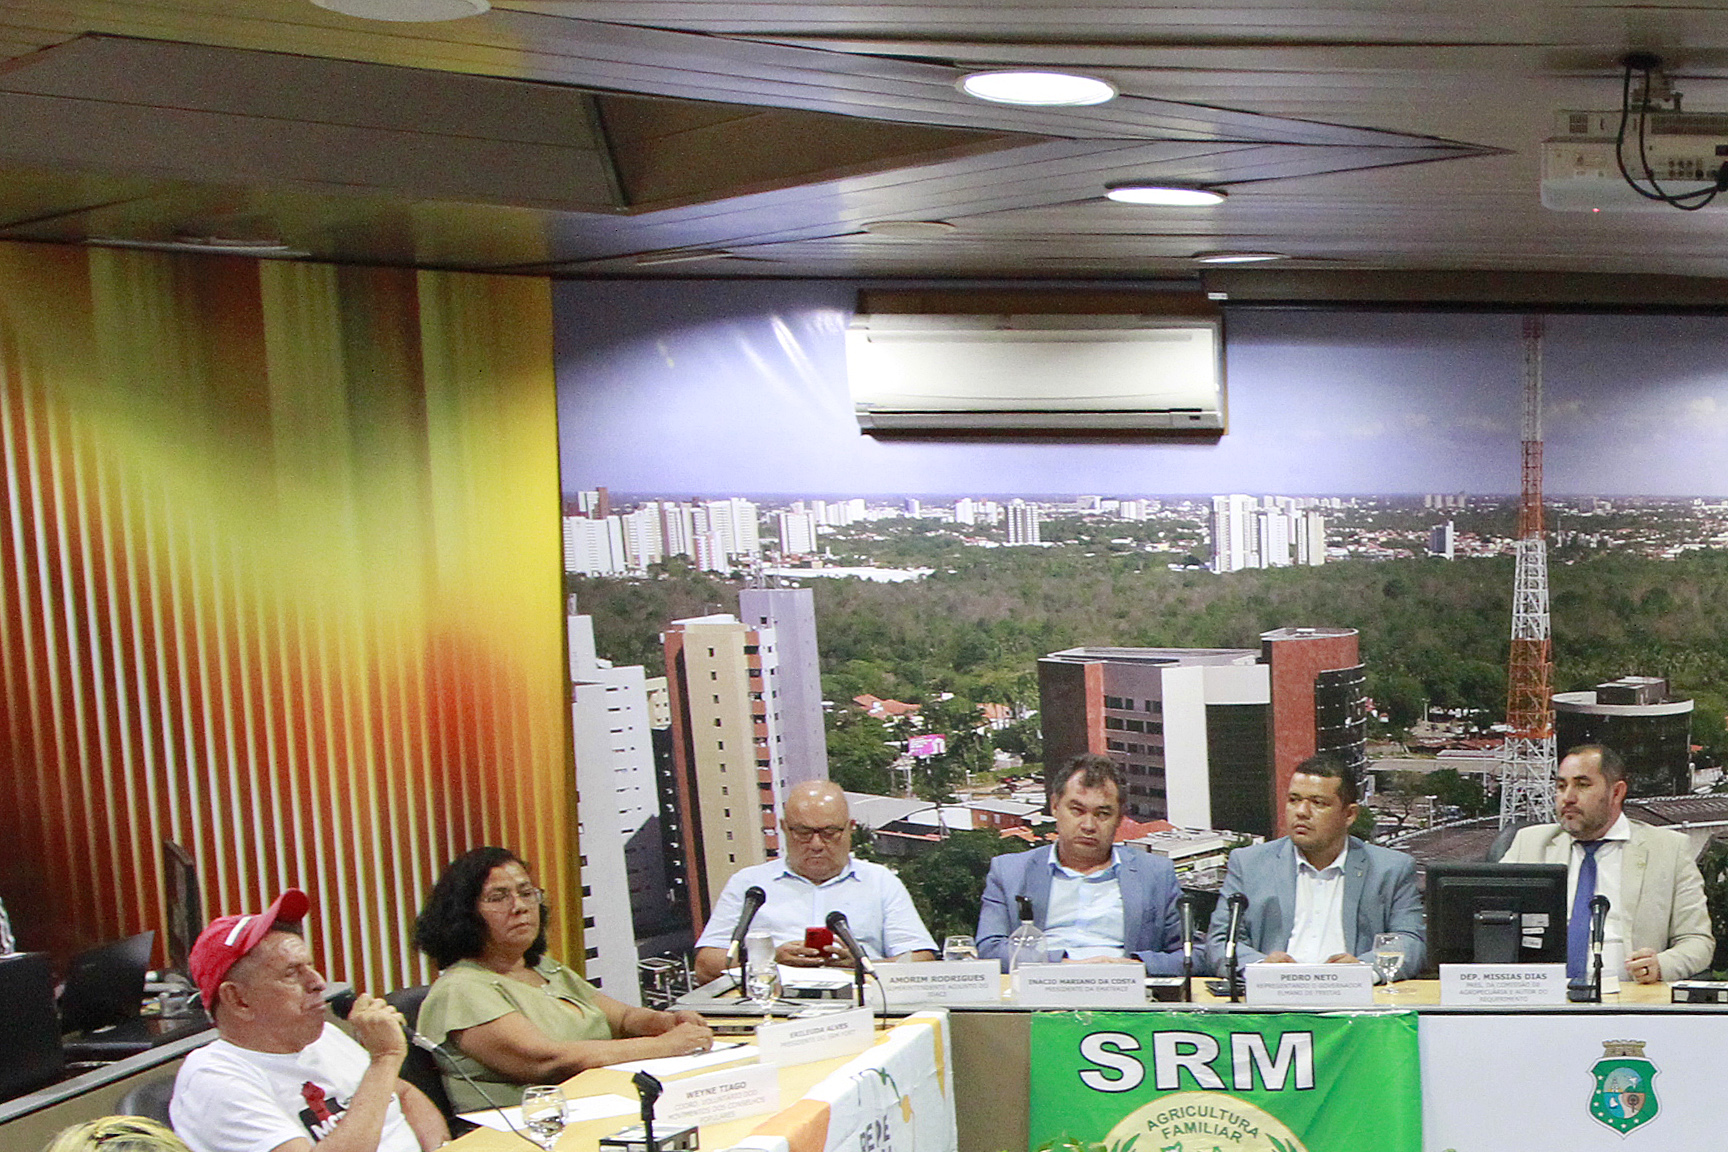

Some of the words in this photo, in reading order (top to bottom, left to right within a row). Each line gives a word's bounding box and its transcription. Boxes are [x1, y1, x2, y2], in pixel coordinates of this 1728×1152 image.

[931, 974, 985, 982] RODRIGUES
[1078, 1030, 1316, 1093] SRM
[686, 1086, 716, 1099] WEYNE
[719, 1081, 747, 1092] TIAGO
[1147, 1105, 1259, 1139] AGRICULTURA
[1161, 1122, 1242, 1143] FAMILIAR
